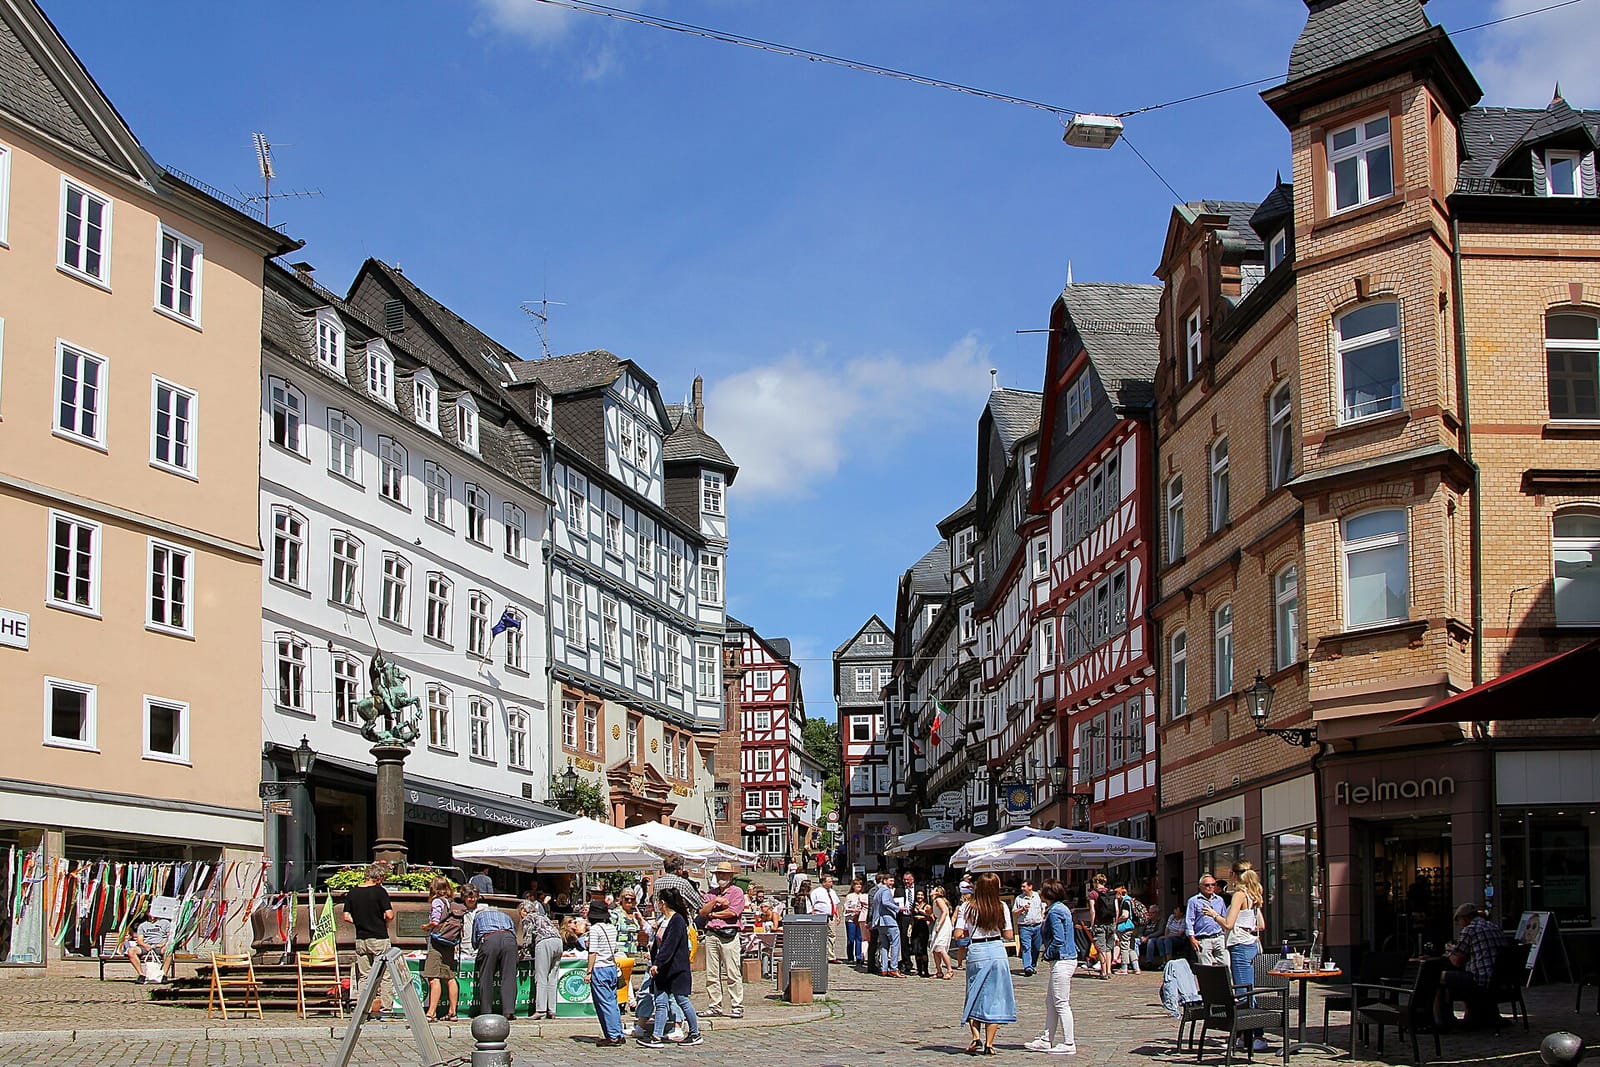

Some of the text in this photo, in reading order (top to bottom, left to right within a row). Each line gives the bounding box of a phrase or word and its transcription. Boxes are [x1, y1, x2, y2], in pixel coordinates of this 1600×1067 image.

[1336, 776, 1455, 806] fielmann
[437, 796, 477, 817] Edlunds
[1193, 816, 1236, 841] fielmann
[455, 970, 481, 979] RENT
[516, 969, 535, 978] UTU
